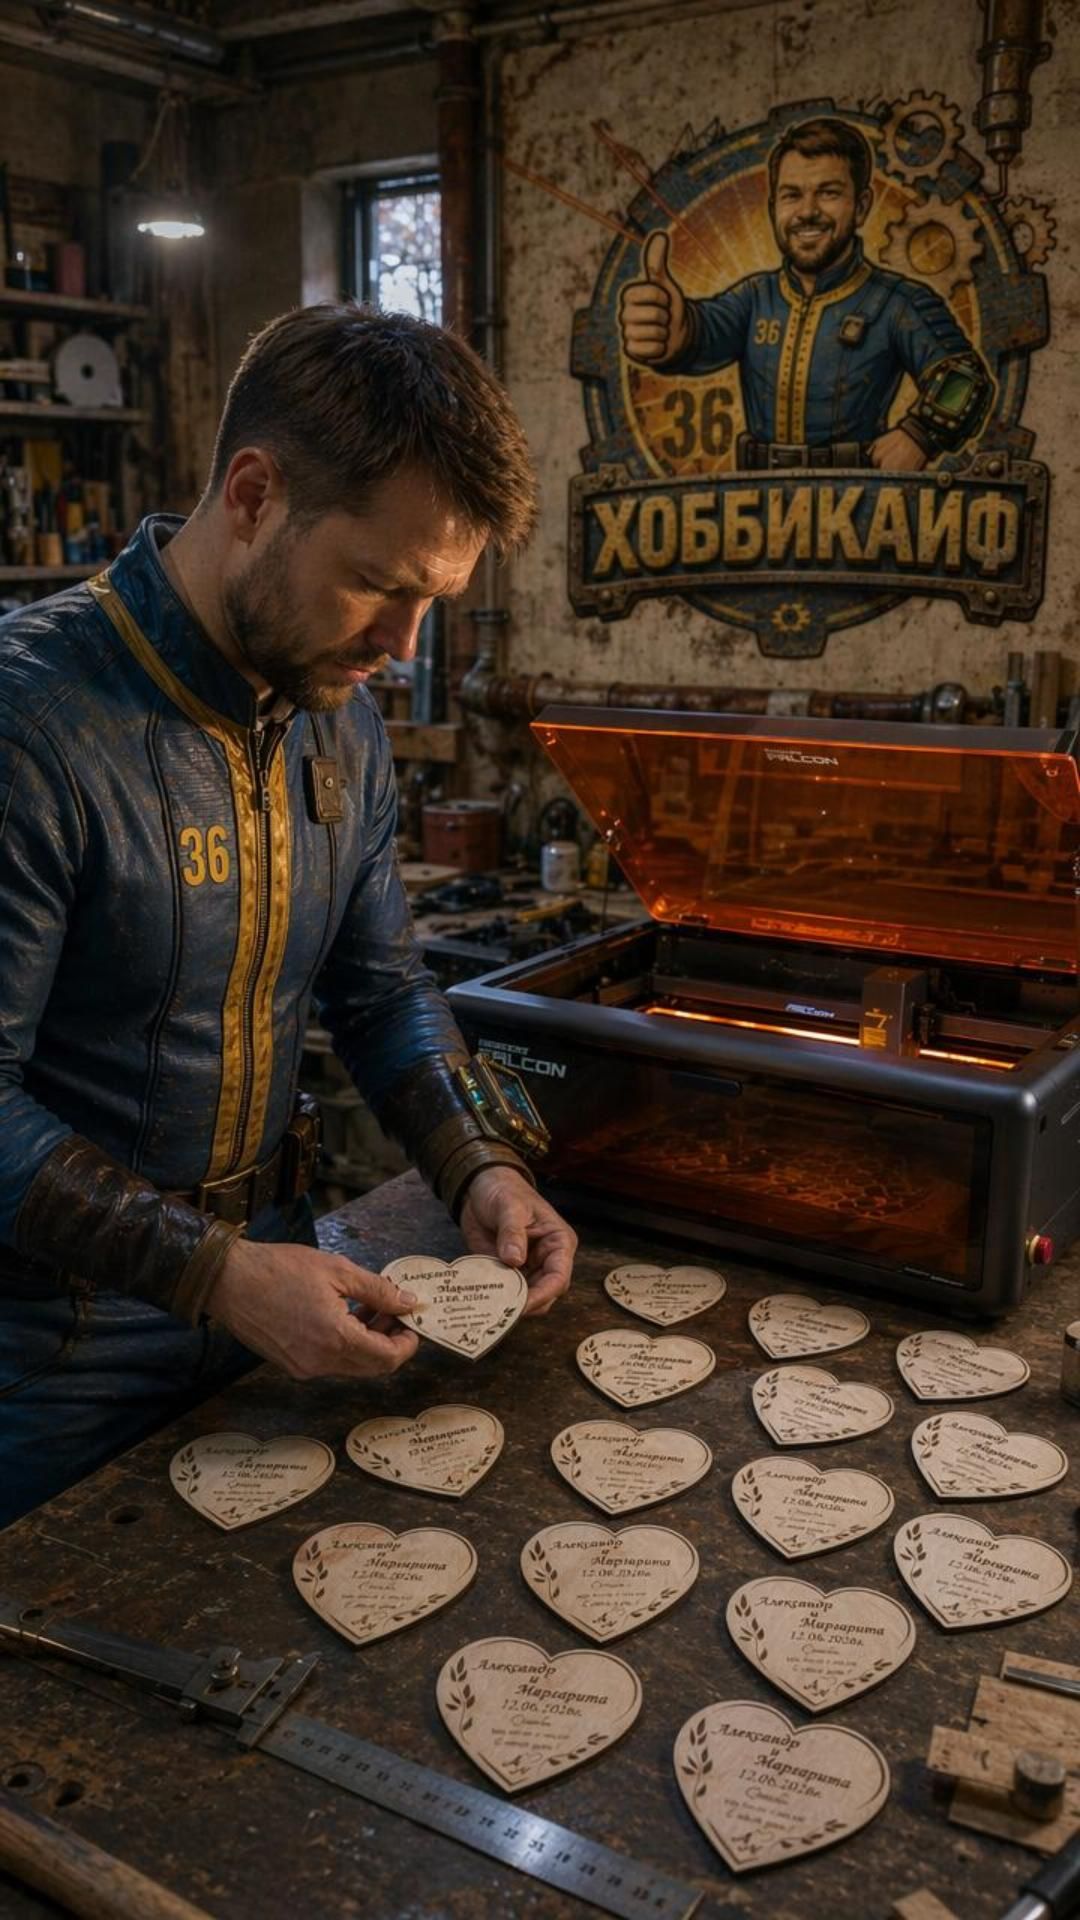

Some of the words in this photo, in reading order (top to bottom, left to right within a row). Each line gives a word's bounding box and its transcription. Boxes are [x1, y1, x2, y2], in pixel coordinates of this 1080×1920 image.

[754, 318, 781, 344] 36
[662, 387, 734, 458] 36
[180, 825, 230, 886] 36
[515, 1684, 608, 1705] Маргарита
[711, 1724, 800, 1752] Александр
[754, 1754, 851, 1789] Маргарита
